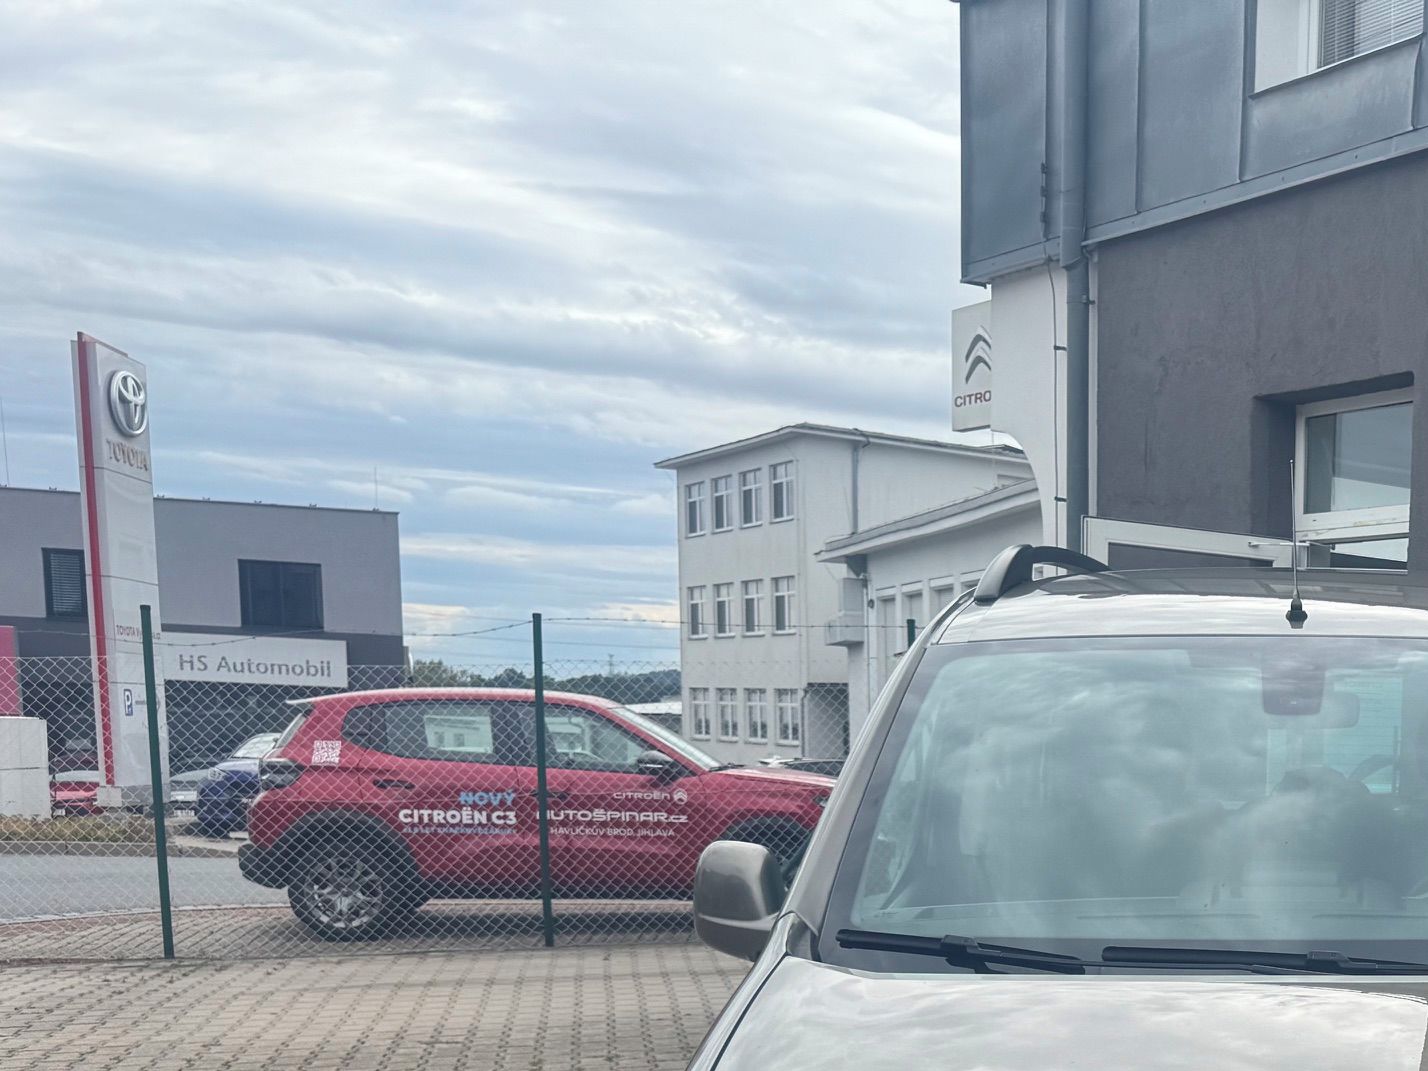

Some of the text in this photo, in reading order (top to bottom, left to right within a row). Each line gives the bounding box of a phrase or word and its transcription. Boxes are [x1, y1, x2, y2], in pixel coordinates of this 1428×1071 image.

[106, 438, 148, 472] TOYOTA
[179, 654, 331, 678] HS Automobil
[459, 789, 515, 806] NOVÝ
[399, 807, 517, 825] CITROËN C3
[637, 828, 675, 837] JIHLAVA
